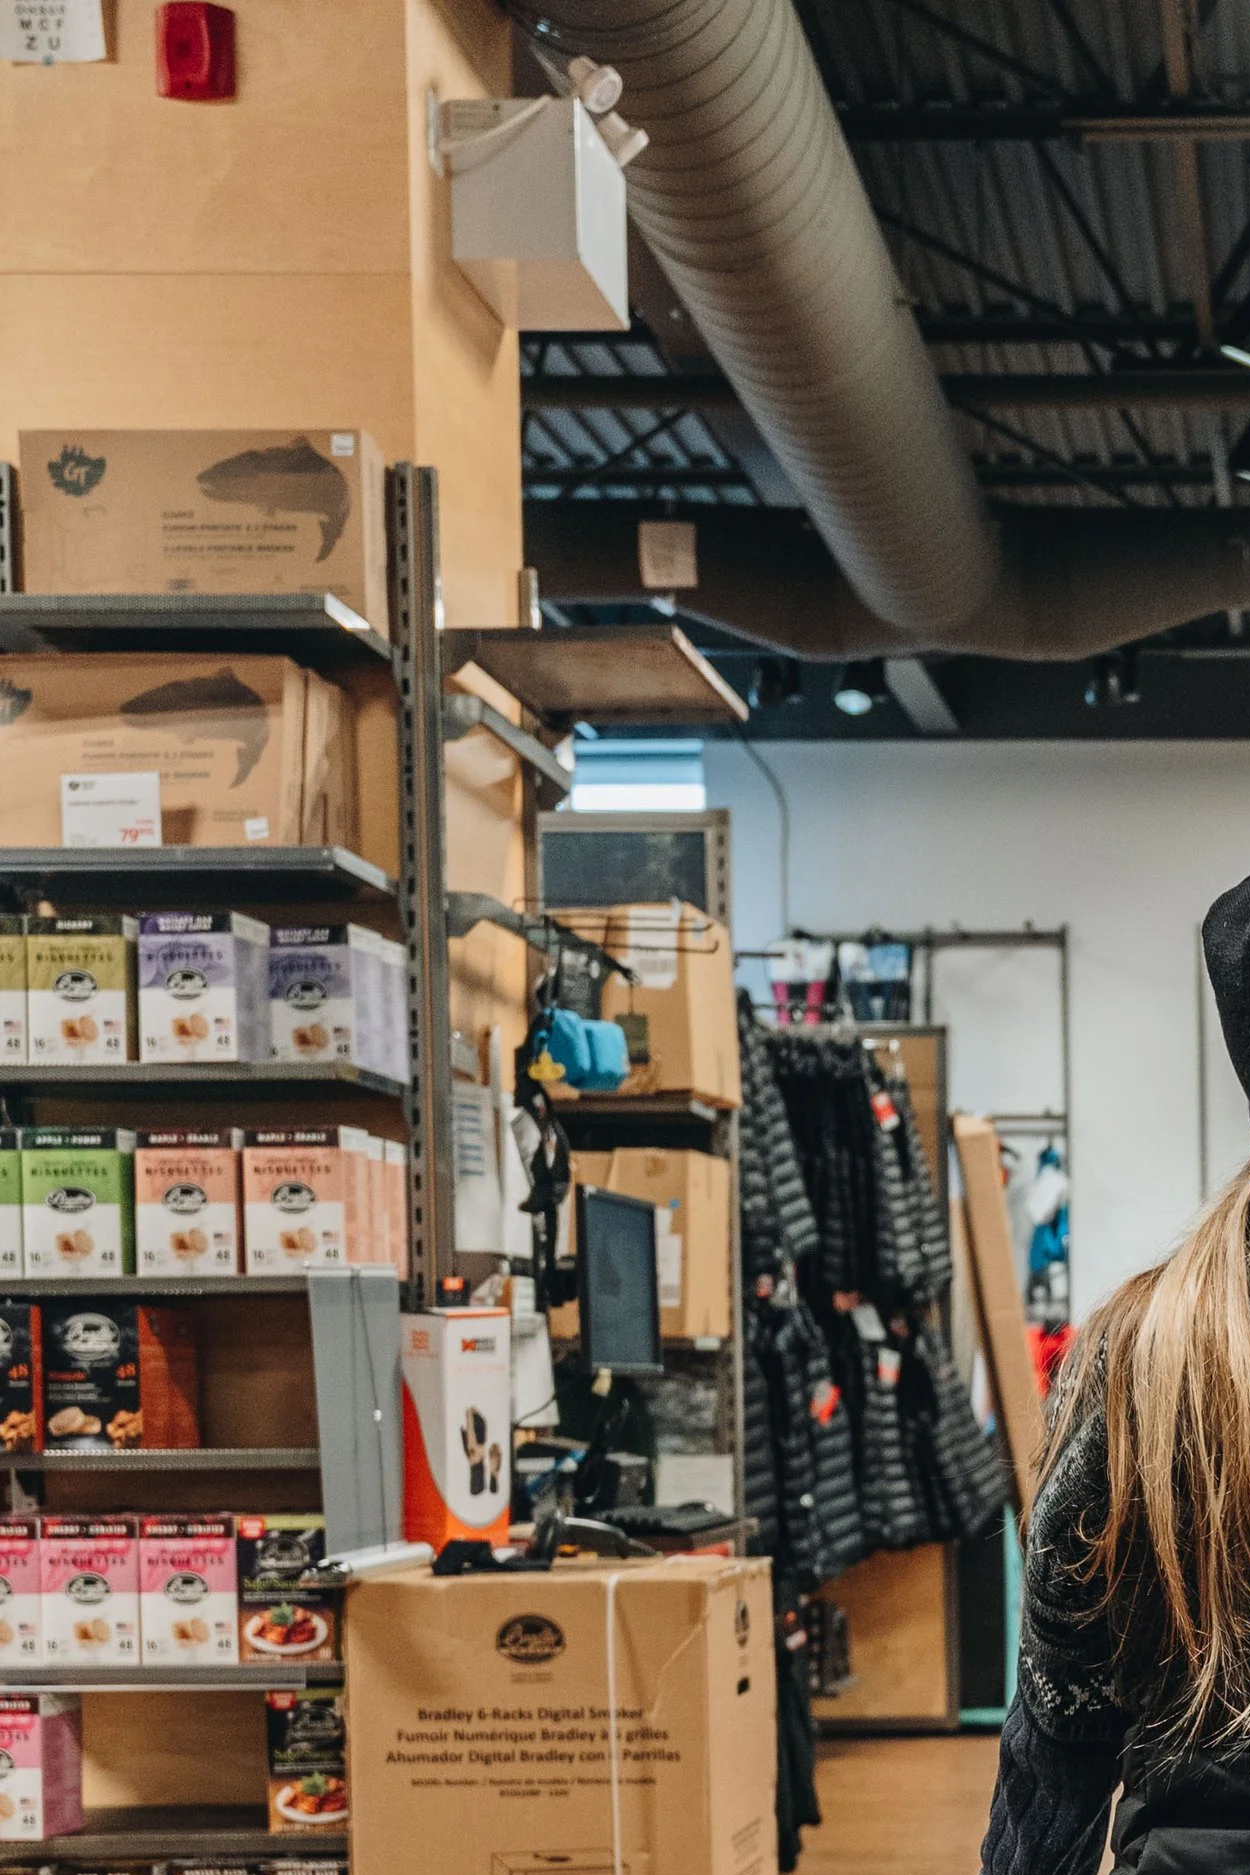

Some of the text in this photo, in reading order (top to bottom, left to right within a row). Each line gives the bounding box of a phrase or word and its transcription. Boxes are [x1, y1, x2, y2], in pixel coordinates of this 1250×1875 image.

[417, 1707, 473, 1723] Bradley
[537, 1707, 585, 1722] Digital
[397, 1729, 448, 1742] Fumoir
[454, 1729, 537, 1743] Numérique
[541, 1728, 595, 1742] Bradley
[386, 1749, 681, 1765] Ahumador Digital Bradley con Parrillas
